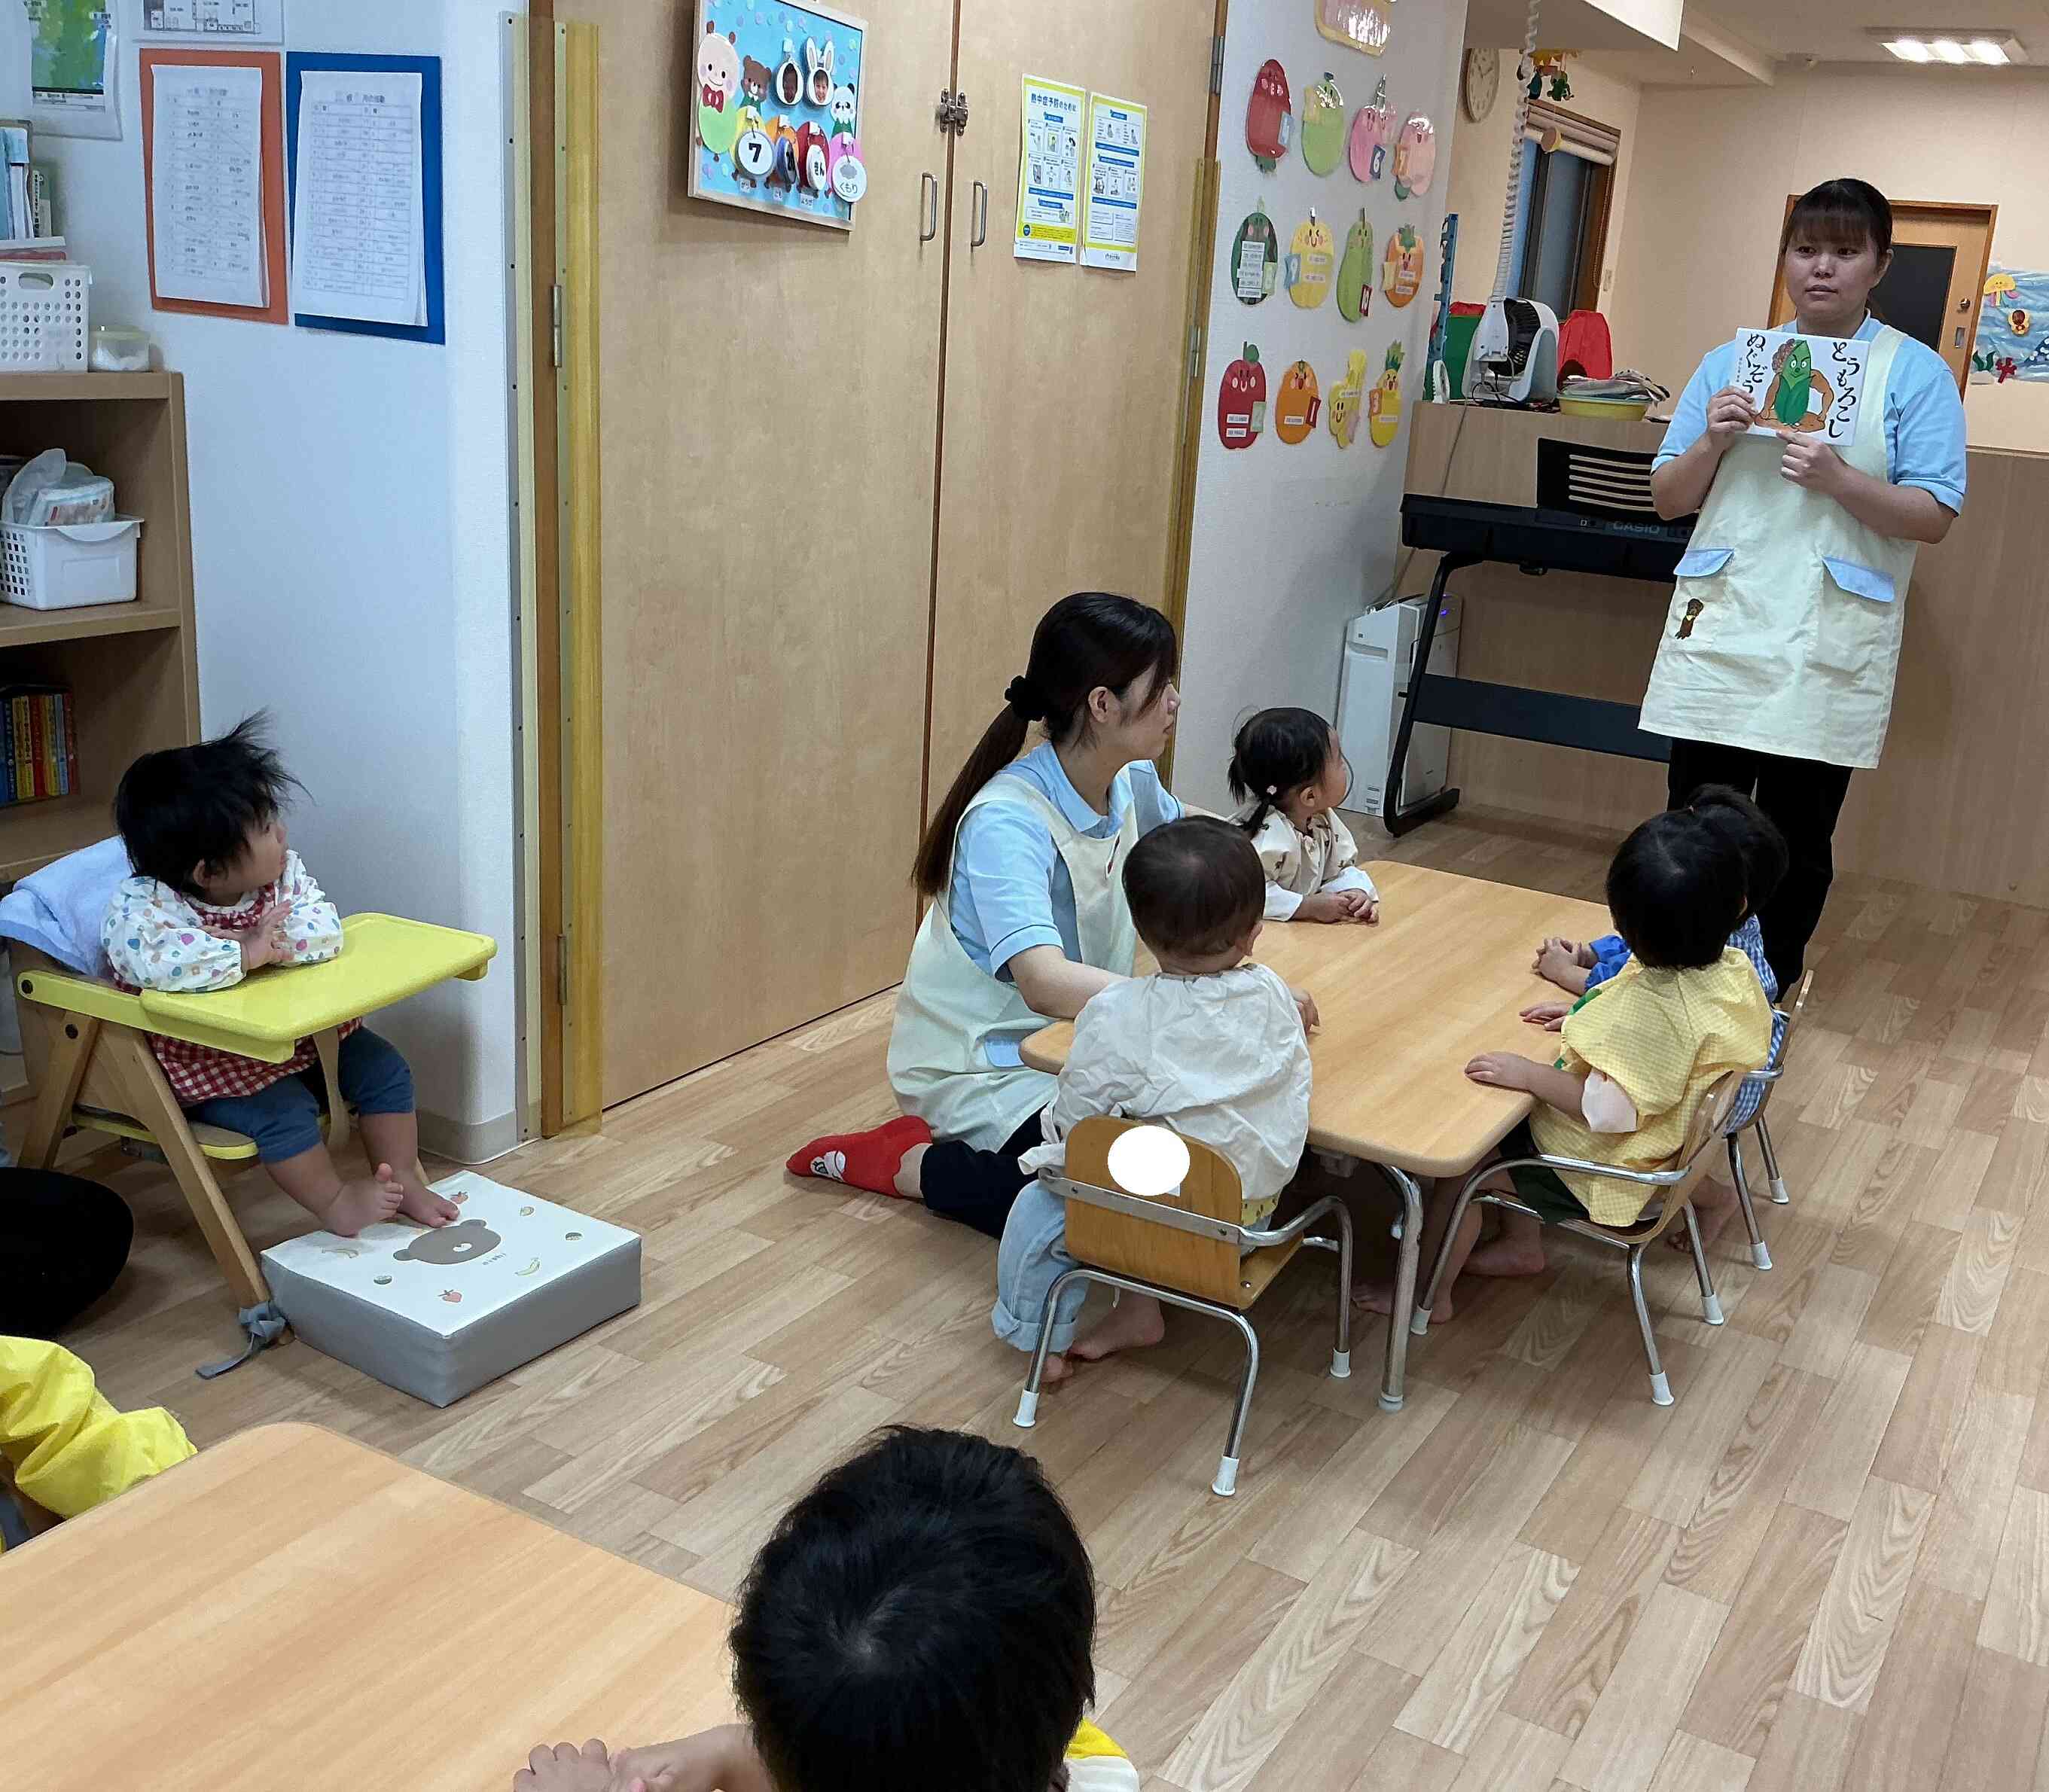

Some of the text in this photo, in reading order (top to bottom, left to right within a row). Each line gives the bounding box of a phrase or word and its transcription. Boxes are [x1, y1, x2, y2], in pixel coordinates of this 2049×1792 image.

[1031, 93, 1077, 112] 熱中症予防のために
[748, 142, 762, 163] 7
[1373, 151, 1381, 173] 6
[814, 162, 825, 176] きん
[840, 182, 858, 194] くもり
[1827, 342, 1861, 438] とうもろこし
[1613, 520, 1660, 534] CASIO
